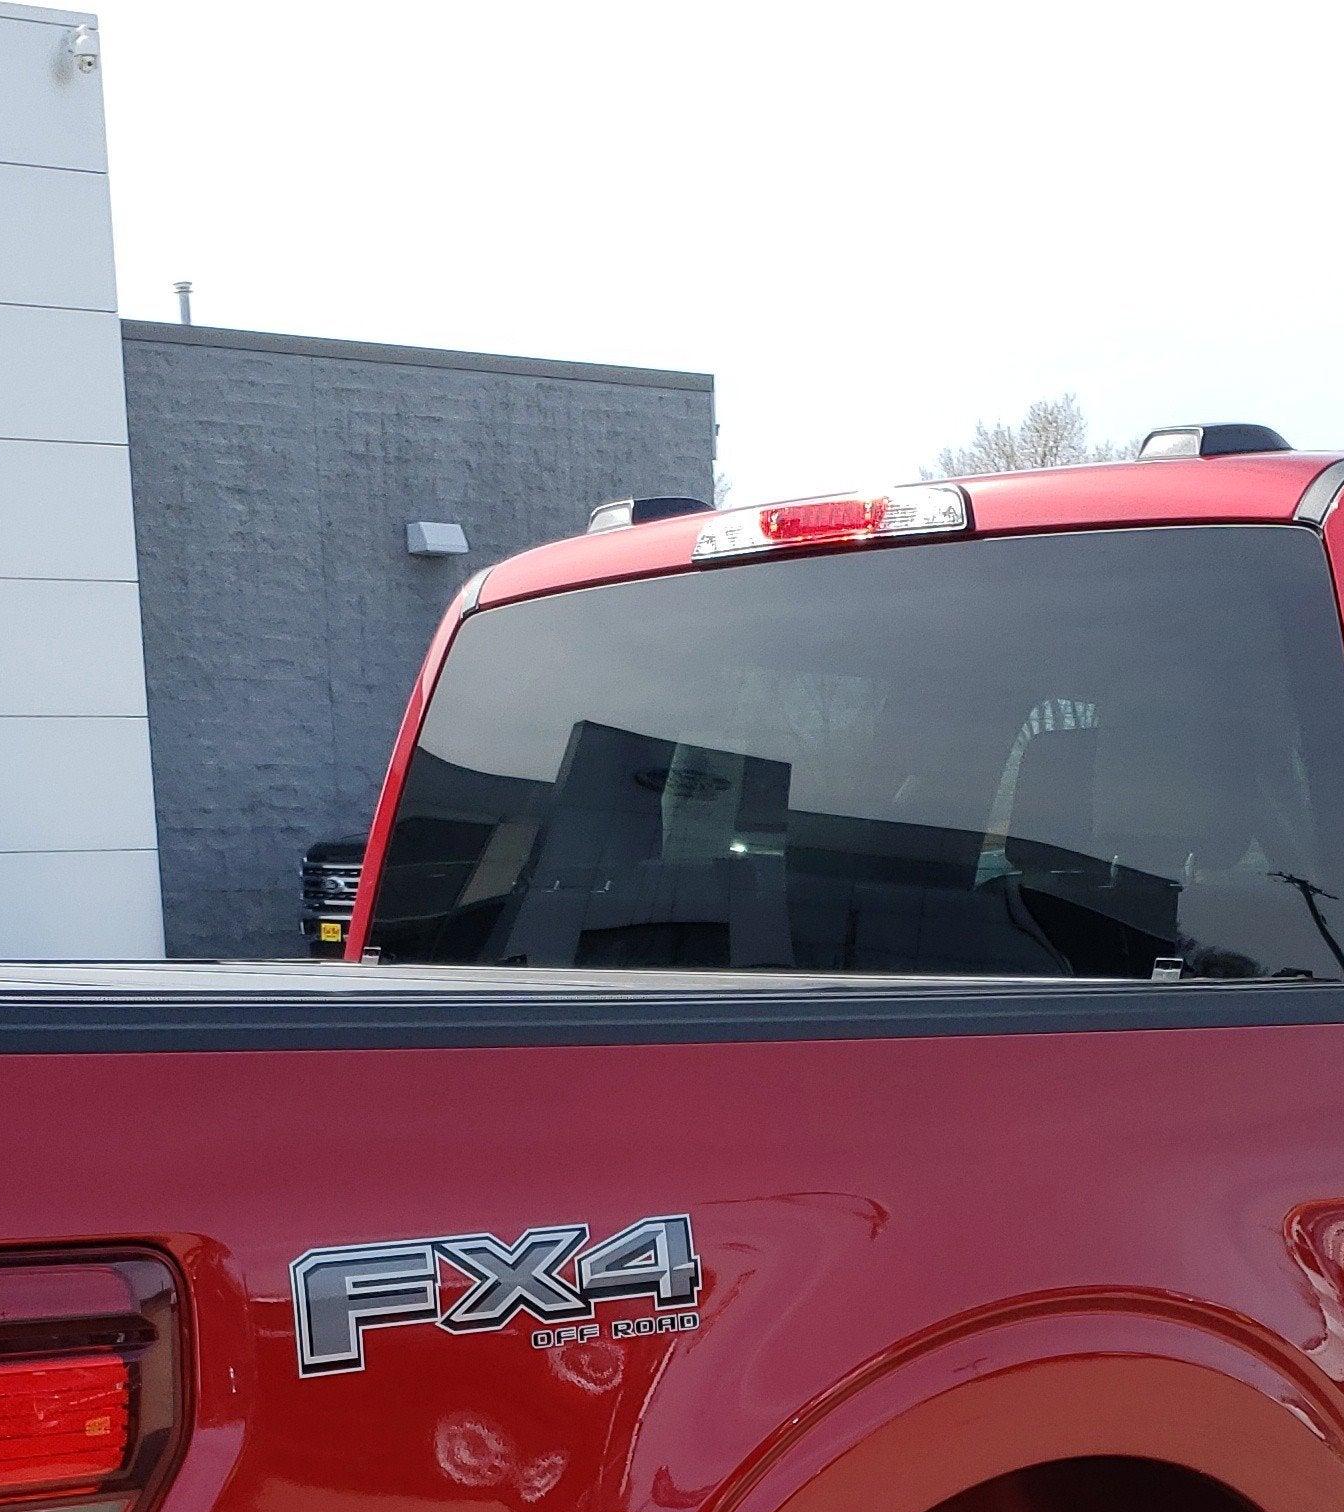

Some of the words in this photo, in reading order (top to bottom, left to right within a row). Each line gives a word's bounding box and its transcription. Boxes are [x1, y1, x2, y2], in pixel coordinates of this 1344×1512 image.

[289, 1213, 703, 1379] FX4
[531, 1322, 600, 1350] OFF
[612, 1311, 701, 1340] ROAD
